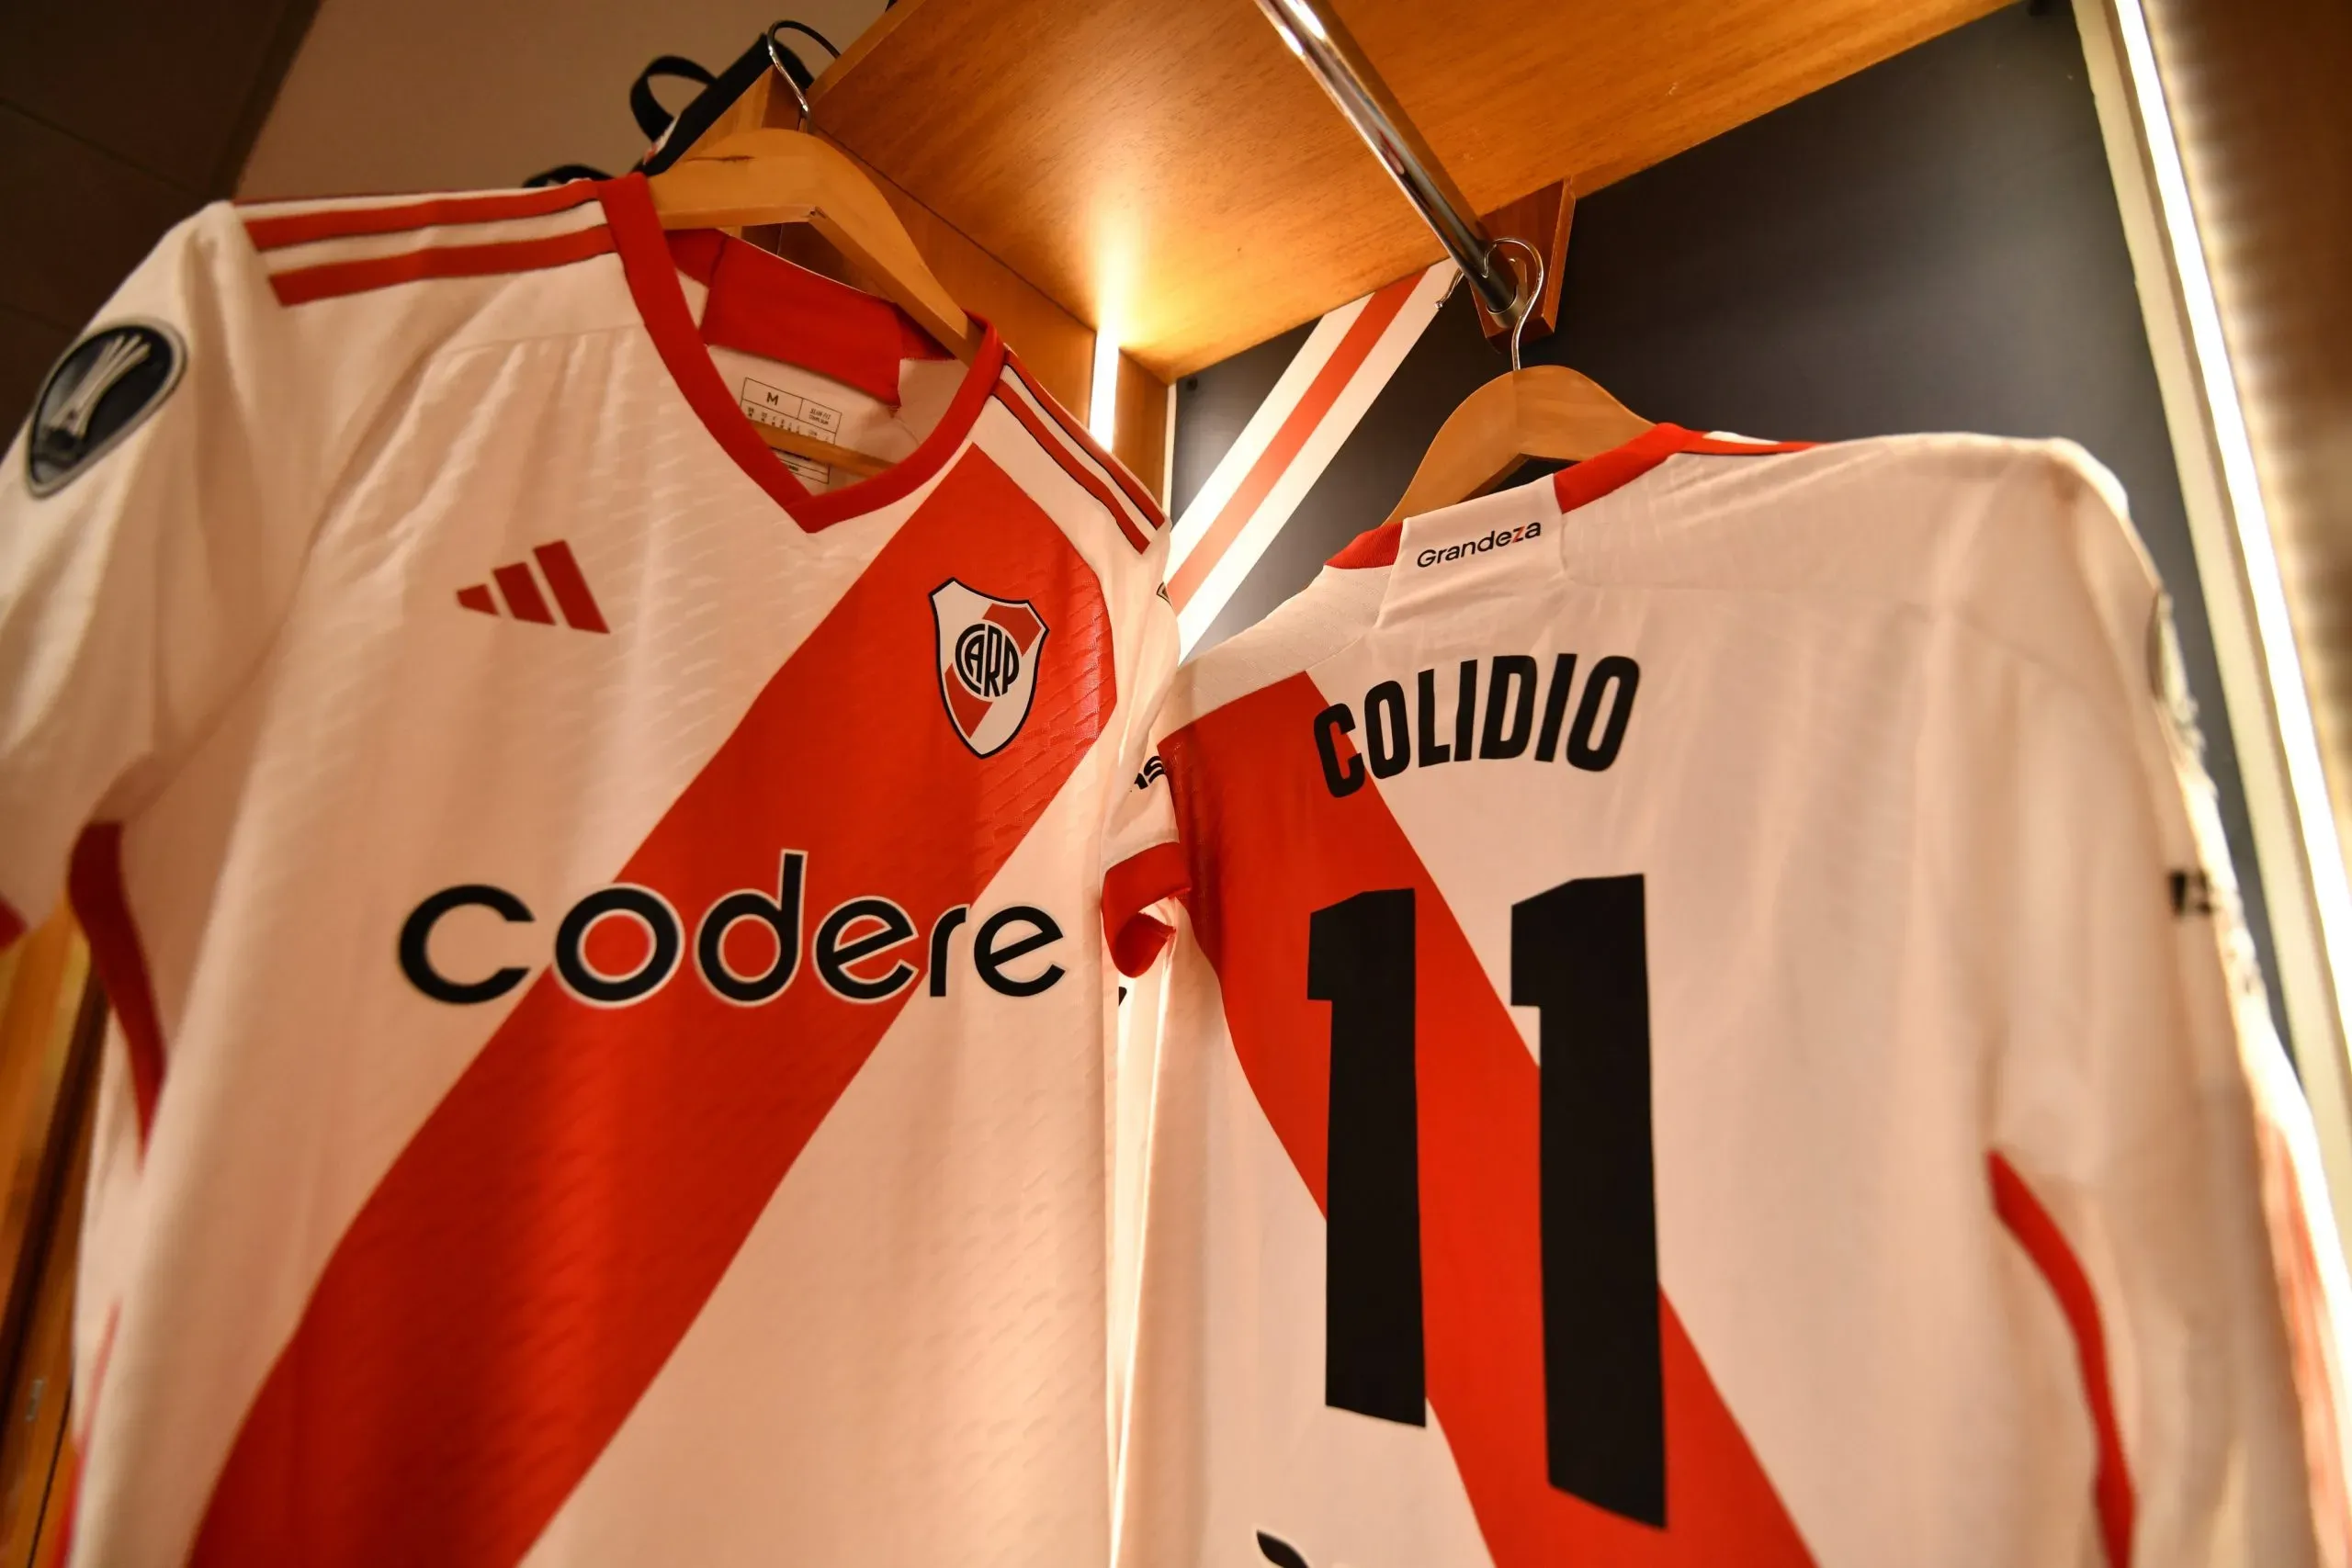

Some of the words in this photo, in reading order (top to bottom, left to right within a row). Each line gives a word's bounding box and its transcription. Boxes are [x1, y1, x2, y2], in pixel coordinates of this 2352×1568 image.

[766, 391, 779, 406] M
[1417, 522, 1542, 568] Grandeza
[955, 623, 1020, 698] CARP
[1313, 653, 1640, 798] COLIDIO
[397, 850, 1067, 1007] codere
[1307, 874, 1668, 1530] 11
